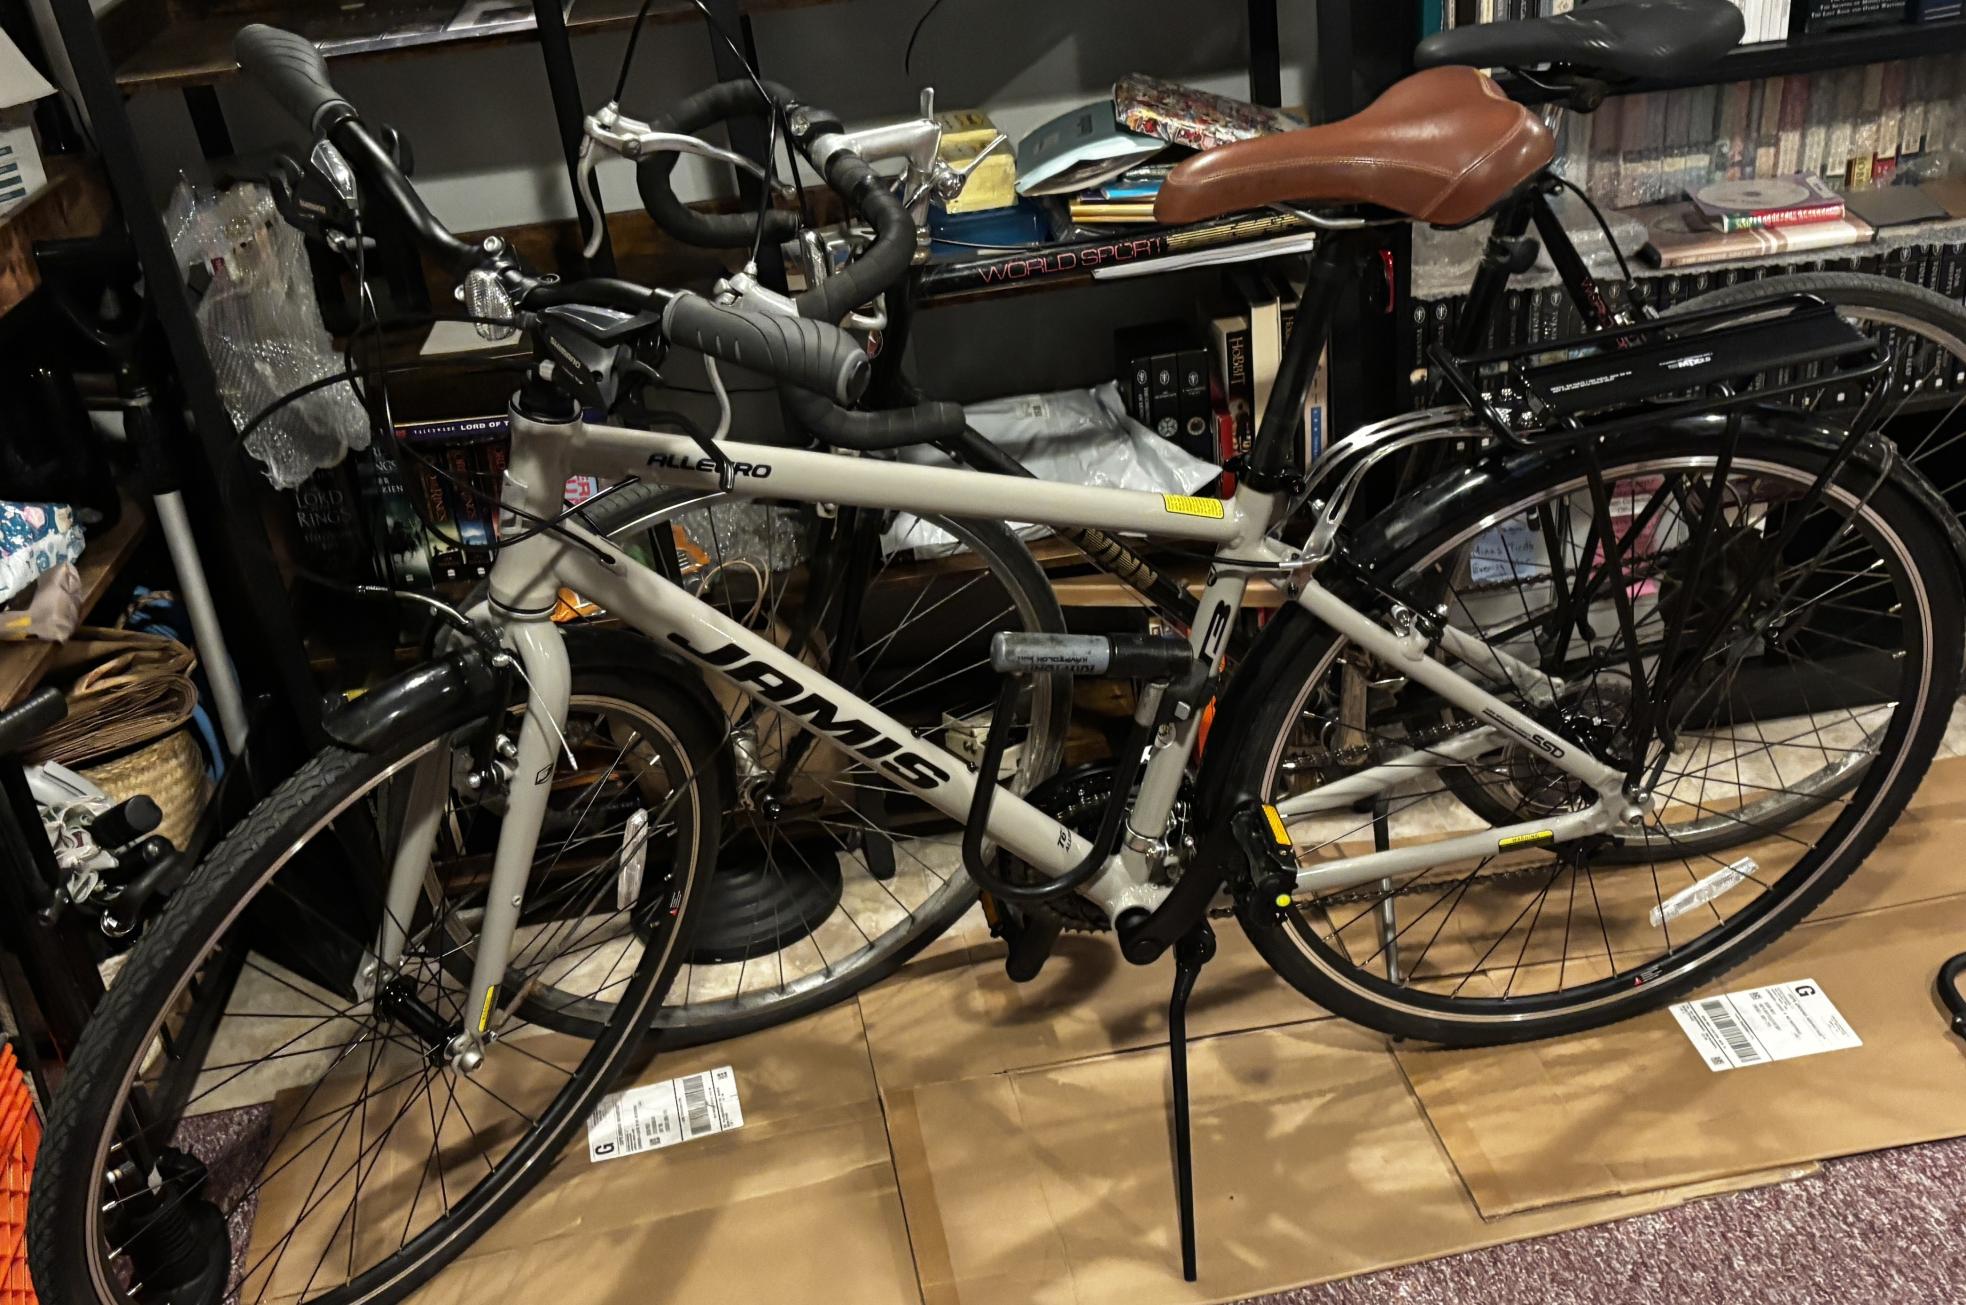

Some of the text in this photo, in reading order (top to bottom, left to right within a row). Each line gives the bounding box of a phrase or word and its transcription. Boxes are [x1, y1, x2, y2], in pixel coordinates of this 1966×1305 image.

[978, 237, 1162, 283] WORLD SPORT
[460, 422, 486, 431] LORD
[489, 421, 501, 429] OF
[647, 452, 772, 479] ALLERO
[667, 632, 951, 789] JAMIS
[1530, 733, 1566, 759] SSD
[1795, 985, 1816, 997] G
[594, 1142, 615, 1156] G
